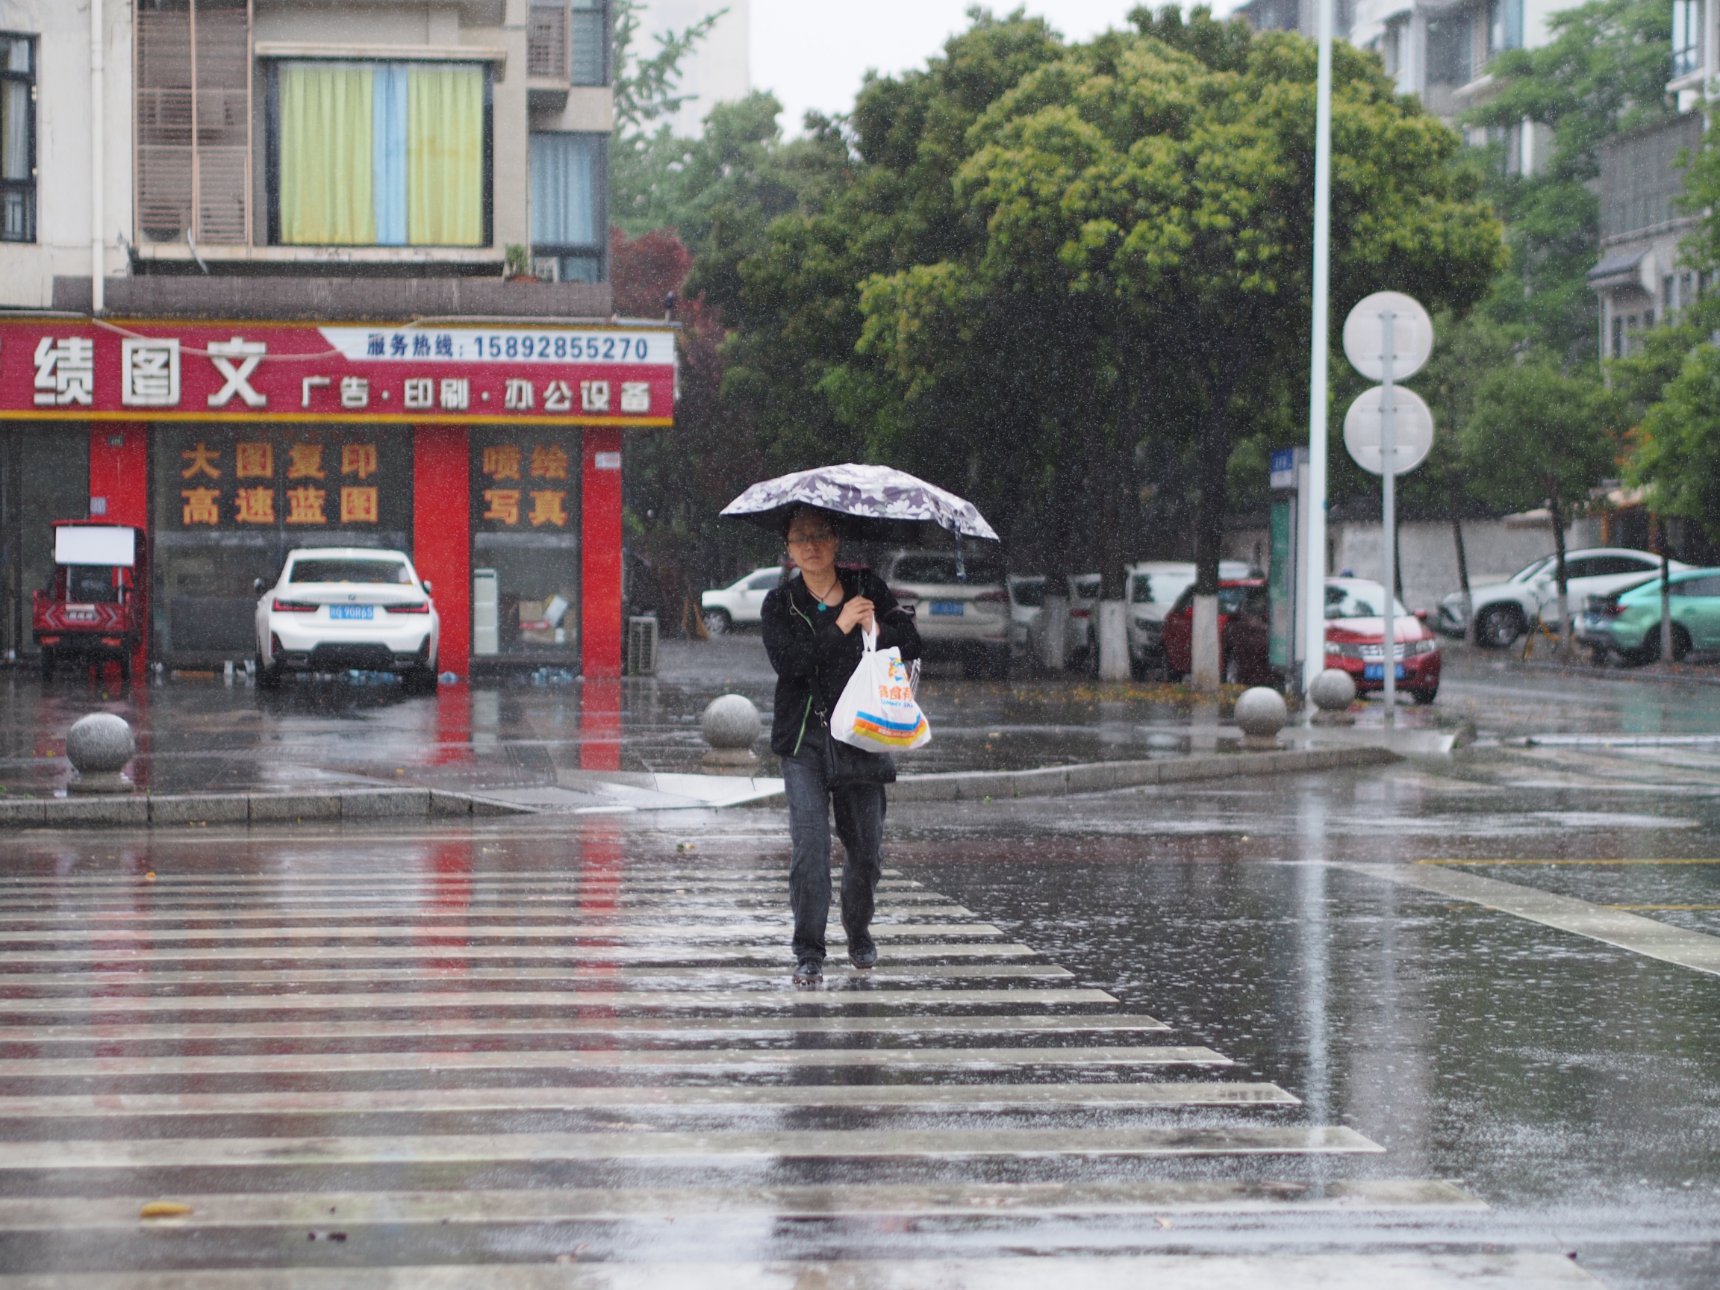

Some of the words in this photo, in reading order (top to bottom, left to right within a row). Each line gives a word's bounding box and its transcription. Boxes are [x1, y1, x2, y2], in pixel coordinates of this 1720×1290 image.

[33, 336, 268, 408] 绩图文
[180, 440, 379, 480] 大图复印
[482, 443, 568, 481] 喷绘
[180, 485, 379, 526] 高速蓝图
[482, 488, 569, 528] 写真
